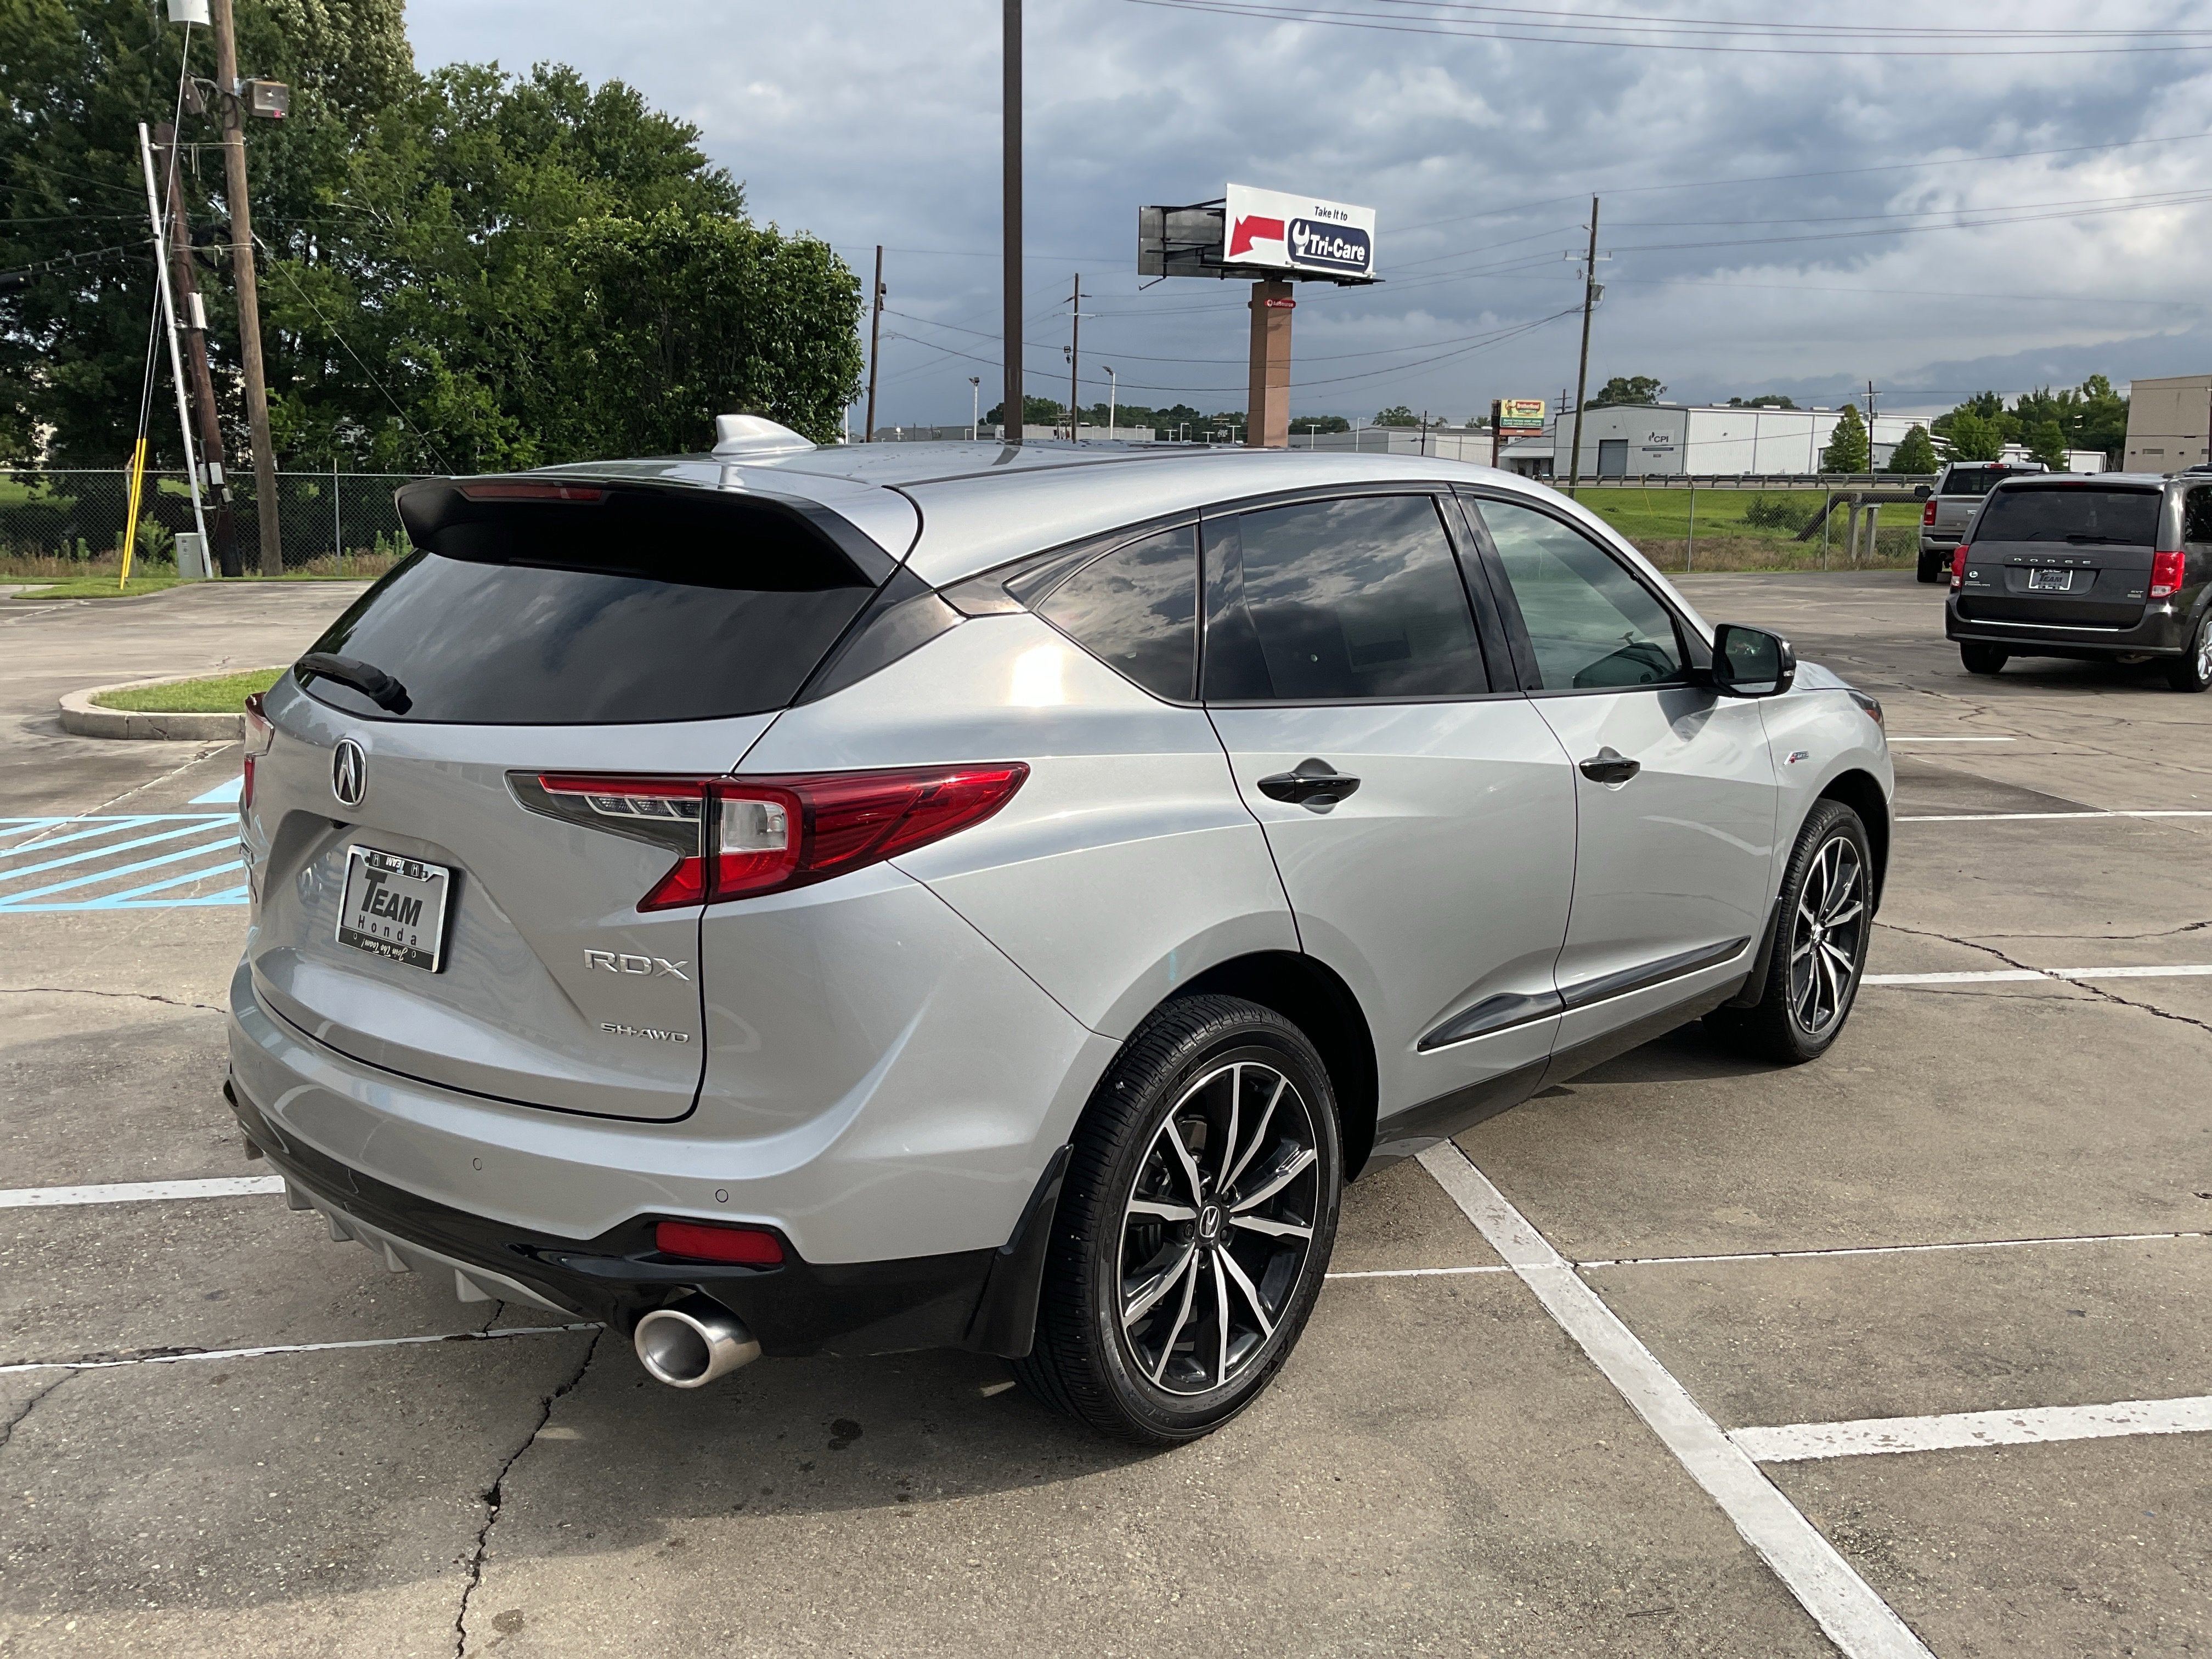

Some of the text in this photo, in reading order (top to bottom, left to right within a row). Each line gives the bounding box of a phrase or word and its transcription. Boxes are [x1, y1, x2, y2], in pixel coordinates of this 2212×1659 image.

[1315, 206, 1348, 221] Take It to
[1310, 234, 1365, 261] Tri-Care
[2039, 573, 2063, 583] TEAM
[386, 856, 405, 874] TEAM
[361, 869, 423, 927] TEAM
[358, 915, 417, 946] Honda
[361, 938, 408, 961] Join The Team!
[584, 949, 690, 980] RDX
[601, 1022, 690, 1043] SH-AWD
